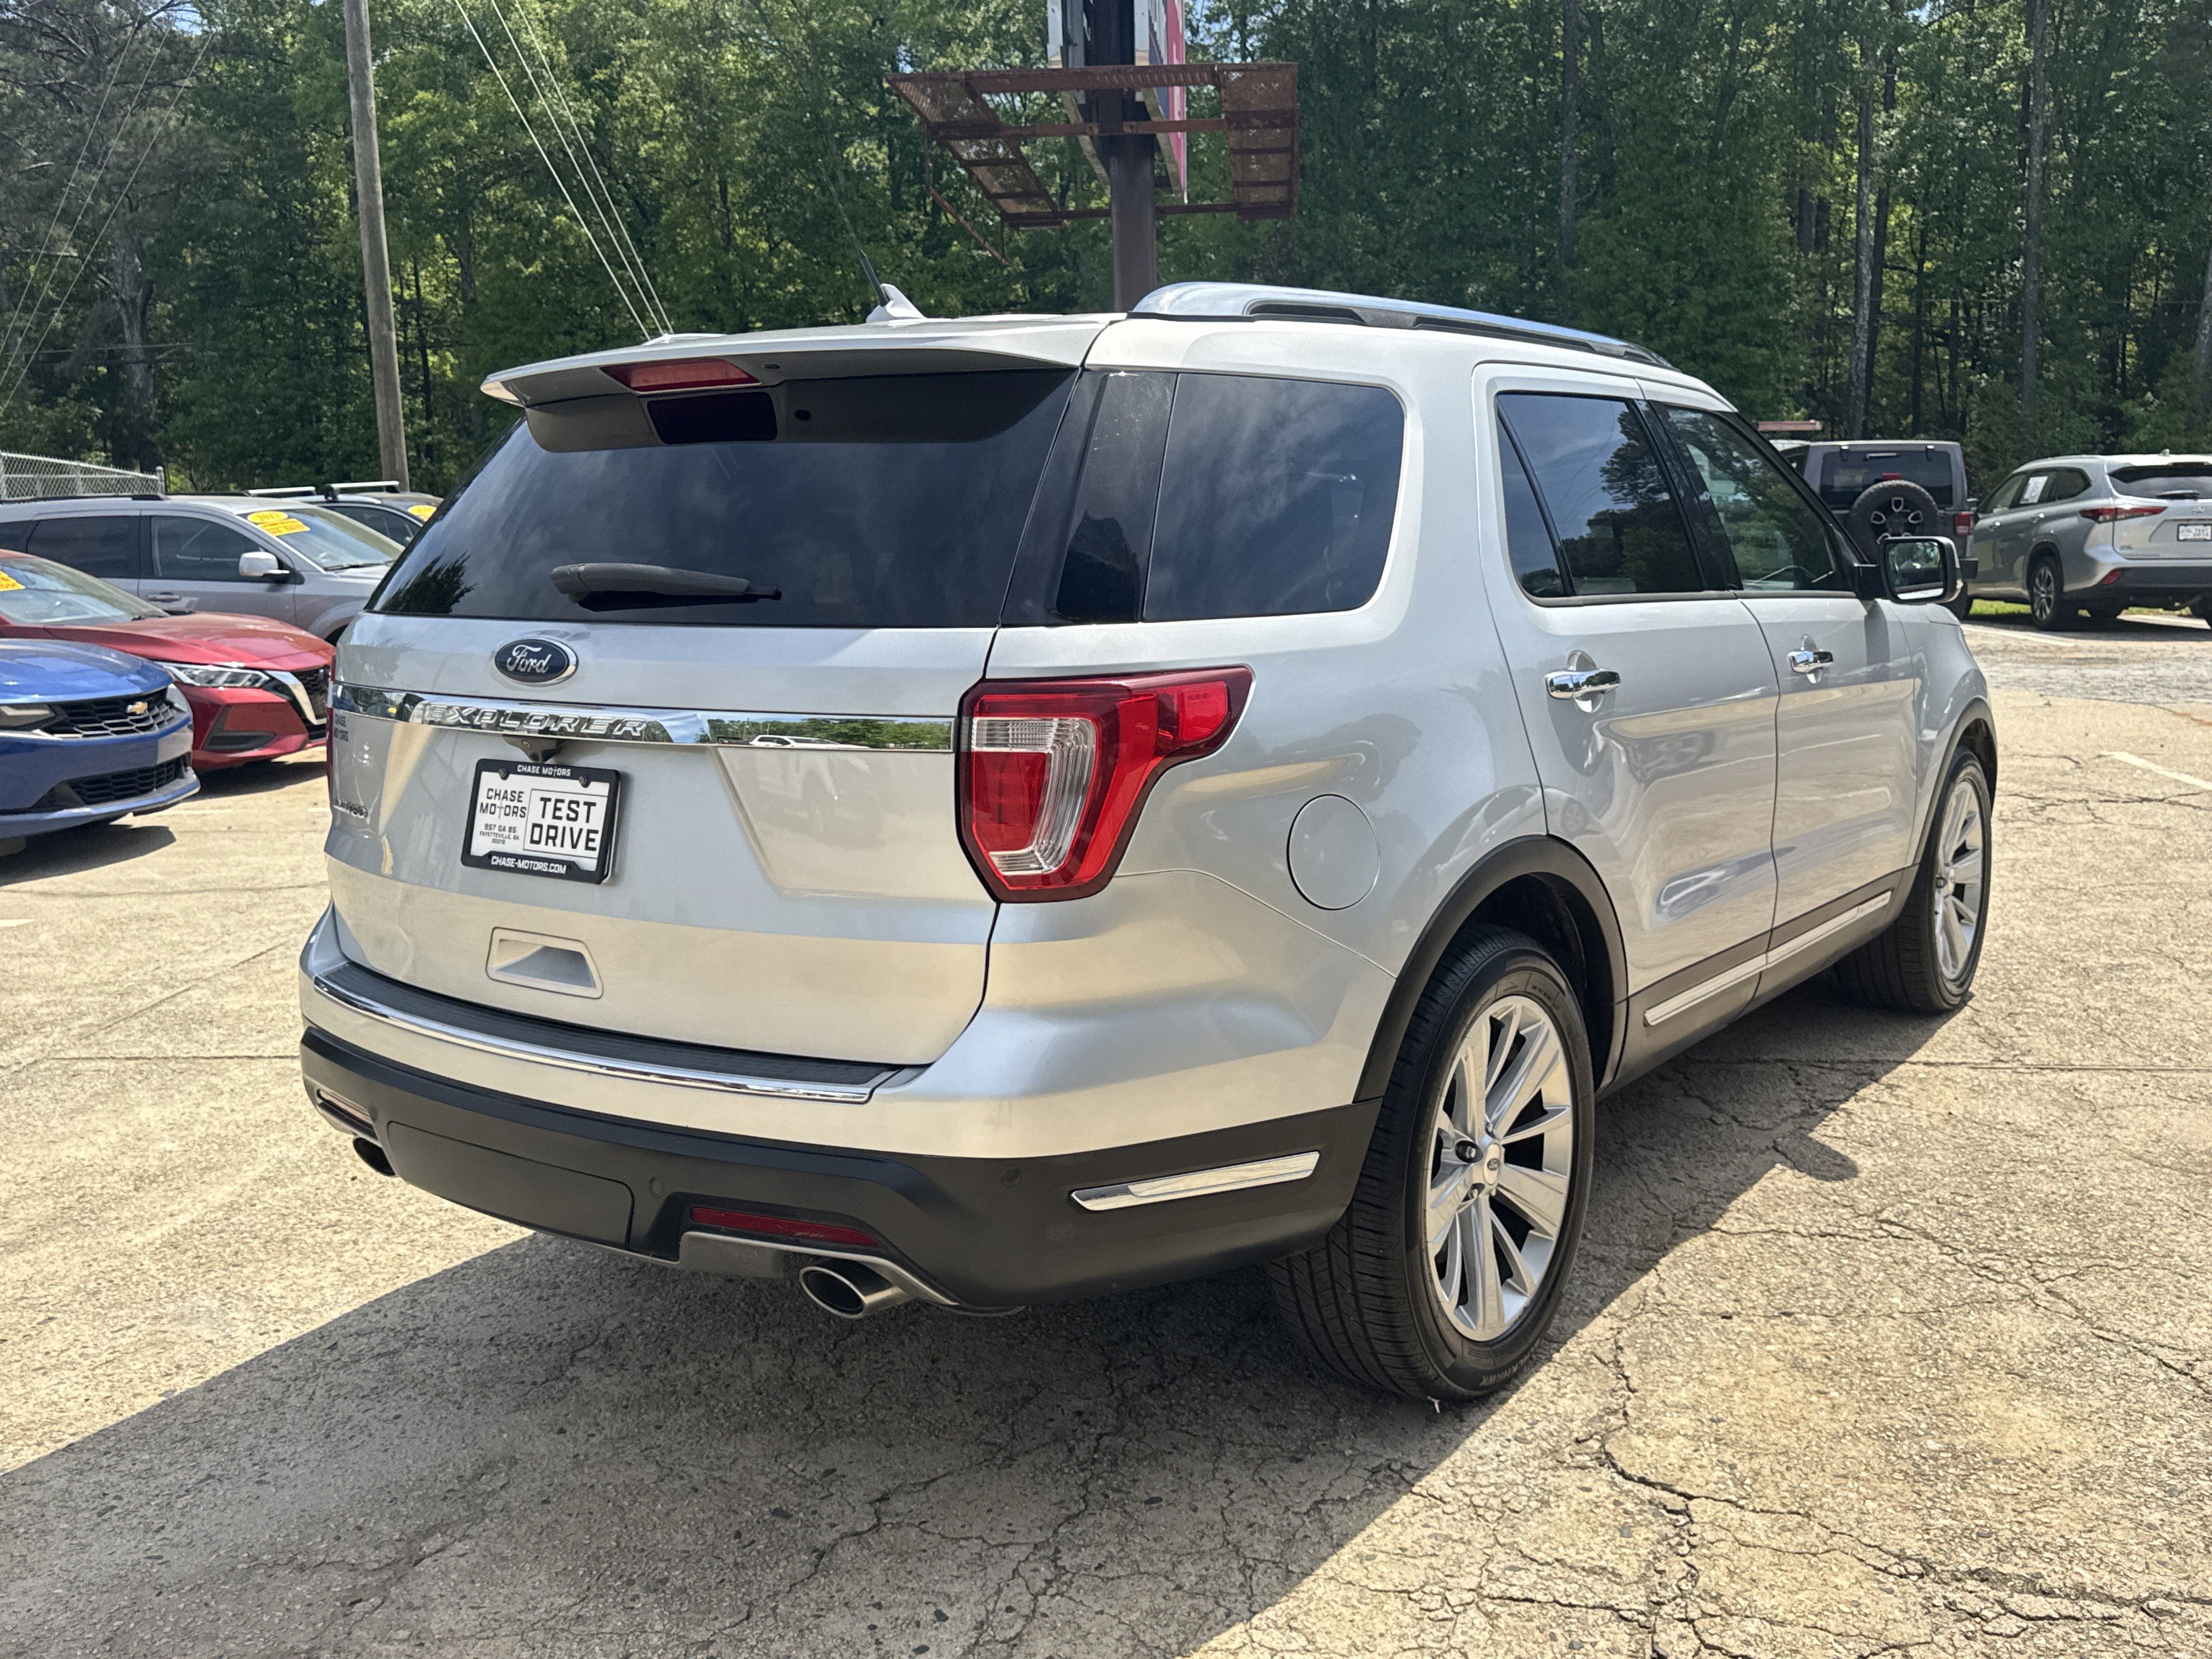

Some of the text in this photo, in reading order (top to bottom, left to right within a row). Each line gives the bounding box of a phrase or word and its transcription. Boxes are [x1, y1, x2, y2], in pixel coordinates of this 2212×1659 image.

[506, 644, 552, 674] Ford
[423, 704, 647, 736] EXPLORER
[517, 764, 572, 777] CHASE MOTORS
[486, 788, 524, 803] CHASE
[479, 801, 527, 819] MOTORS
[540, 797, 597, 823] TEST
[529, 823, 599, 851] DRIVE
[491, 855, 567, 874] CHASE-MOTORS.COM
